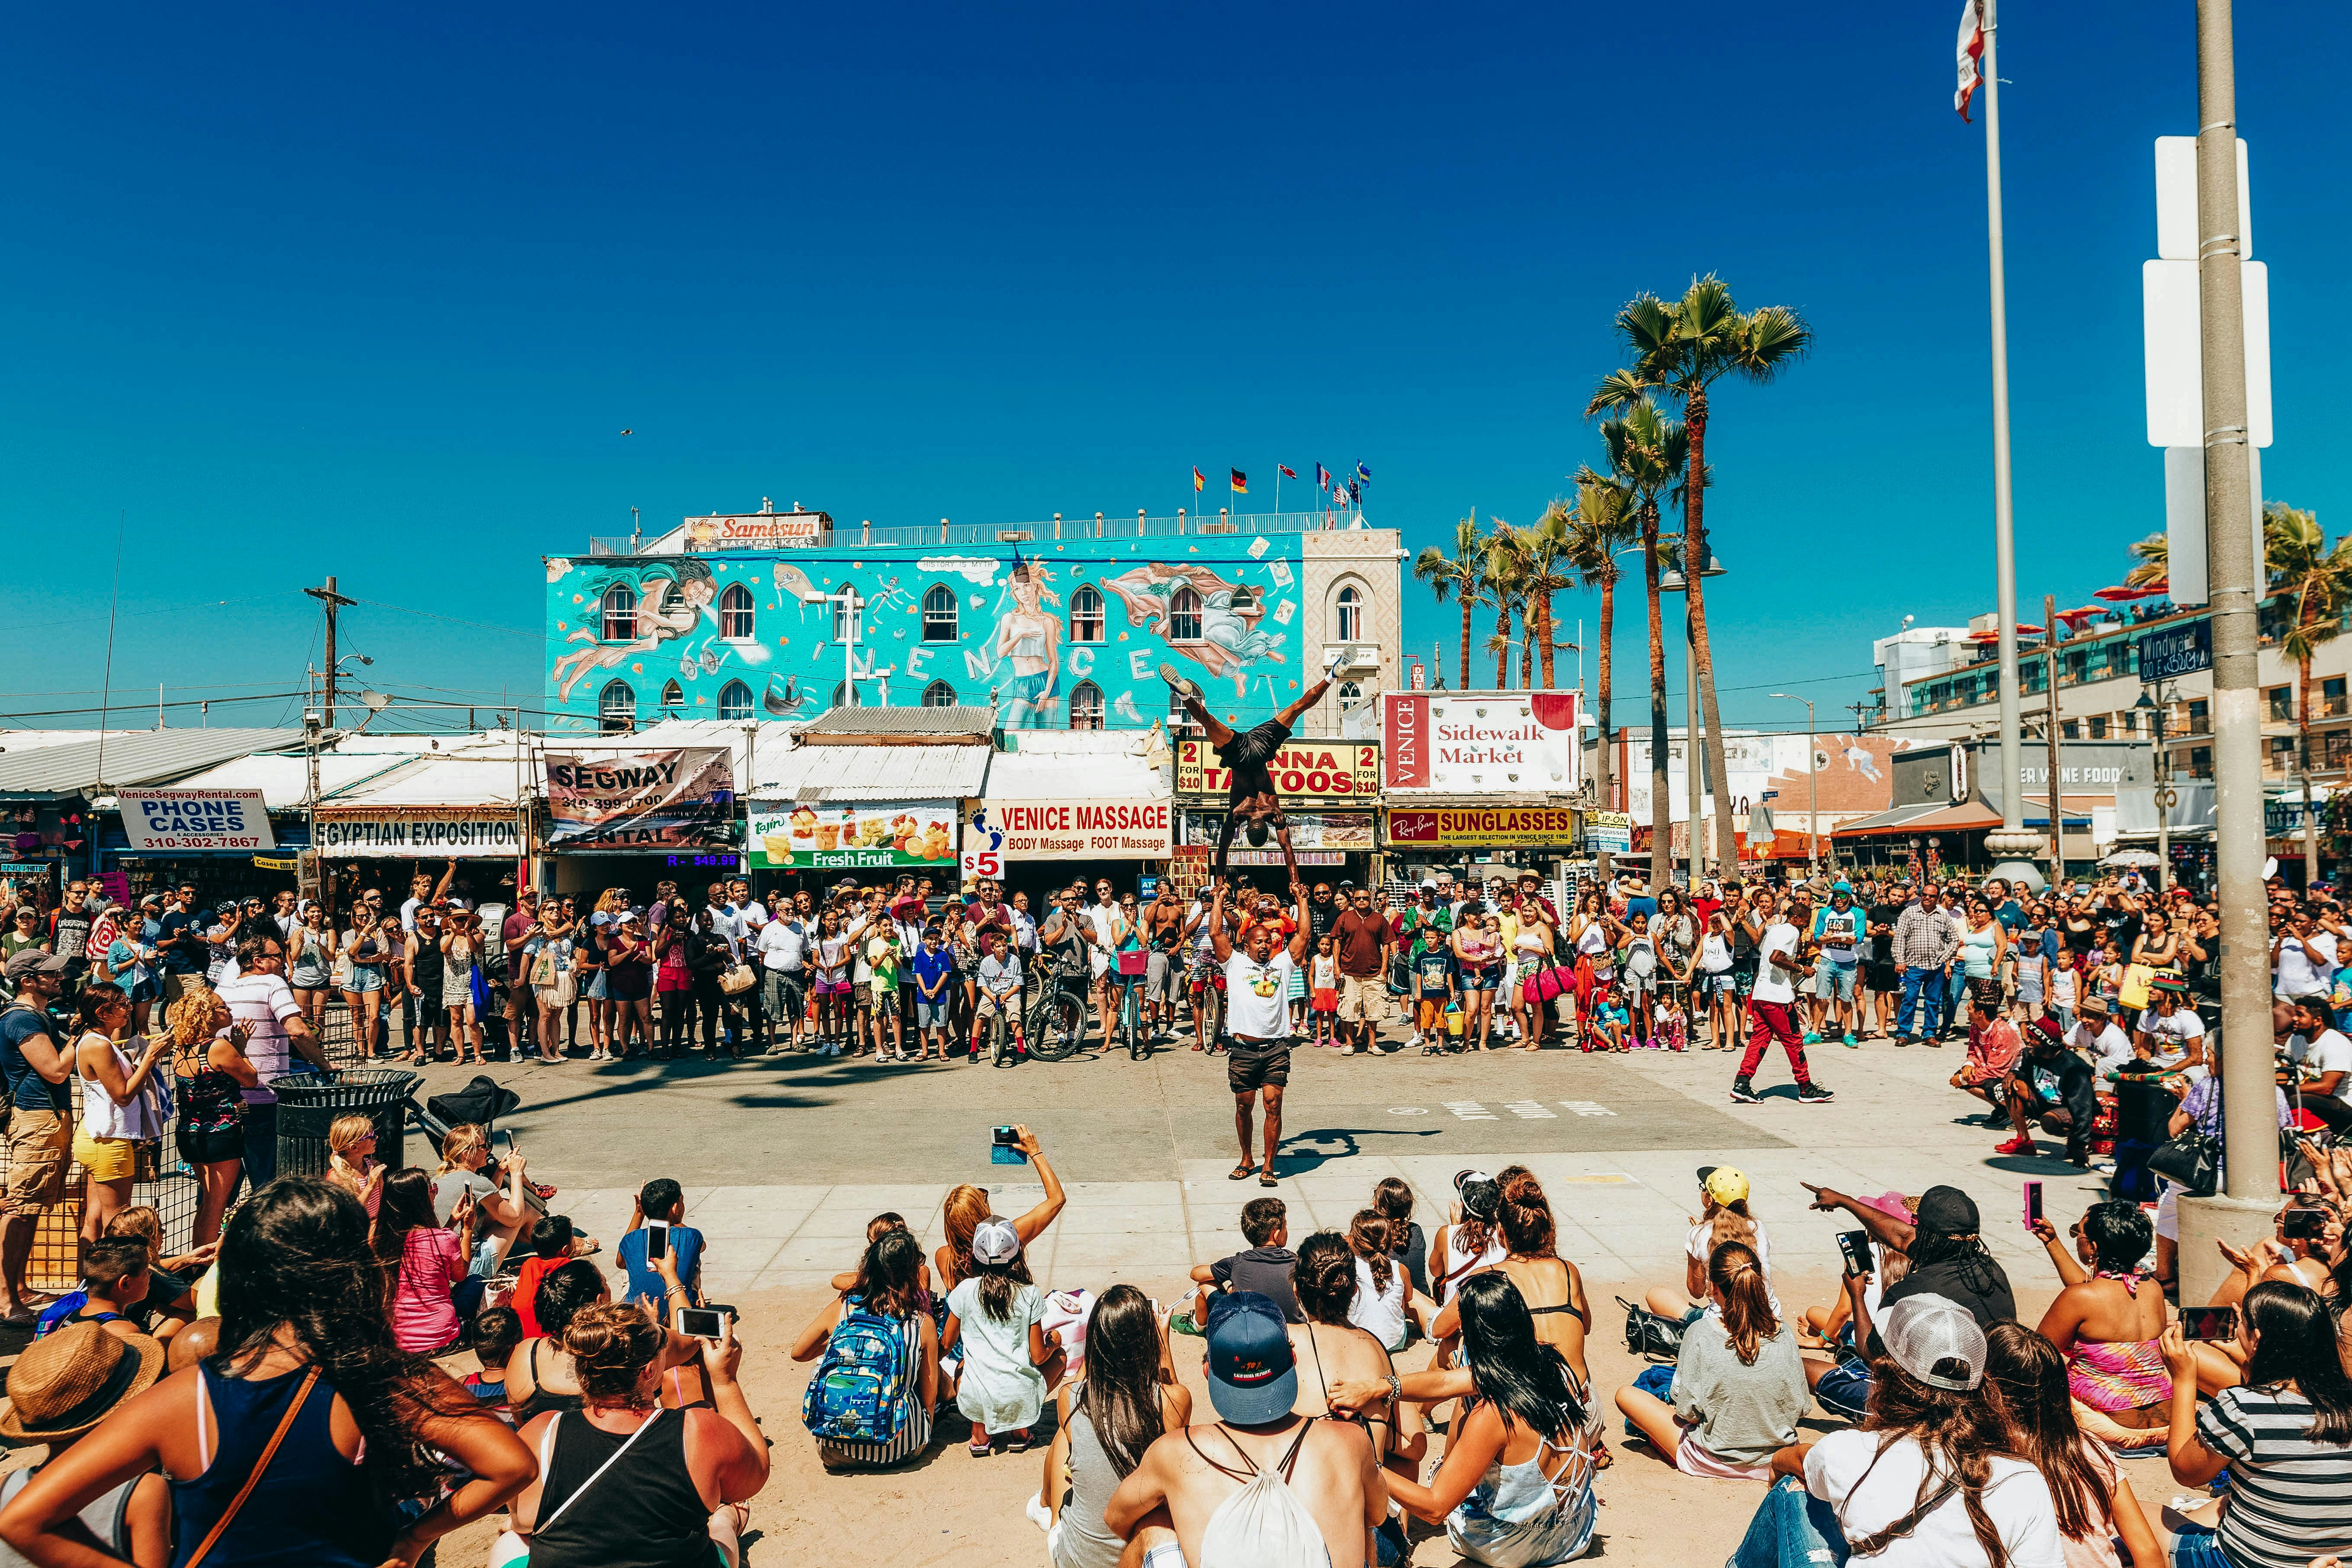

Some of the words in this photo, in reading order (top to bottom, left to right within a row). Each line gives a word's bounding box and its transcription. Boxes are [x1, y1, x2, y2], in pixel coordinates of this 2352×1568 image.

[721, 519, 814, 537] Samesun
[720, 537, 814, 547] BACKPACKERS
[1438, 724, 1545, 741] Sidewalk
[1397, 700, 1415, 782] VENICE
[1183, 742, 1197, 762] 2
[1360, 747, 1374, 766] 2
[1439, 748, 1524, 763] Market
[1267, 751, 1338, 769] NNA
[556, 762, 678, 789] SEGWAY
[1179, 776, 1200, 789] $10
[1203, 769, 1353, 793] TATOOS
[2084, 767, 2120, 783] FOOD
[1356, 781, 1377, 793] $10
[118, 790, 258, 800] VeniceSegwayRental.com
[562, 795, 663, 810] 310-399-0700
[141, 801, 244, 816] PHONE
[766, 803, 782, 812] ZING
[149, 817, 245, 832] CASES
[1001, 807, 1070, 831] VENICE
[1077, 805, 1168, 830] MASSAGE
[1393, 815, 1435, 837] Ray-Ban
[1441, 811, 1568, 832] SUNGLASSES
[1599, 815, 1628, 824] IP-ON
[316, 822, 405, 846] EGYPTIAN
[414, 821, 519, 845] EXPOSITION
[143, 837, 260, 848] 310-302-7867
[1009, 838, 1037, 850] BODY
[1040, 838, 1084, 852] Massage
[1091, 837, 1119, 849] FOOT
[1122, 837, 1165, 851] Massage
[257, 859, 277, 867] Cases
[694, 856, 736, 866] $49.99
[813, 852, 854, 866] Fresh
[858, 851, 893, 866] Fruit
